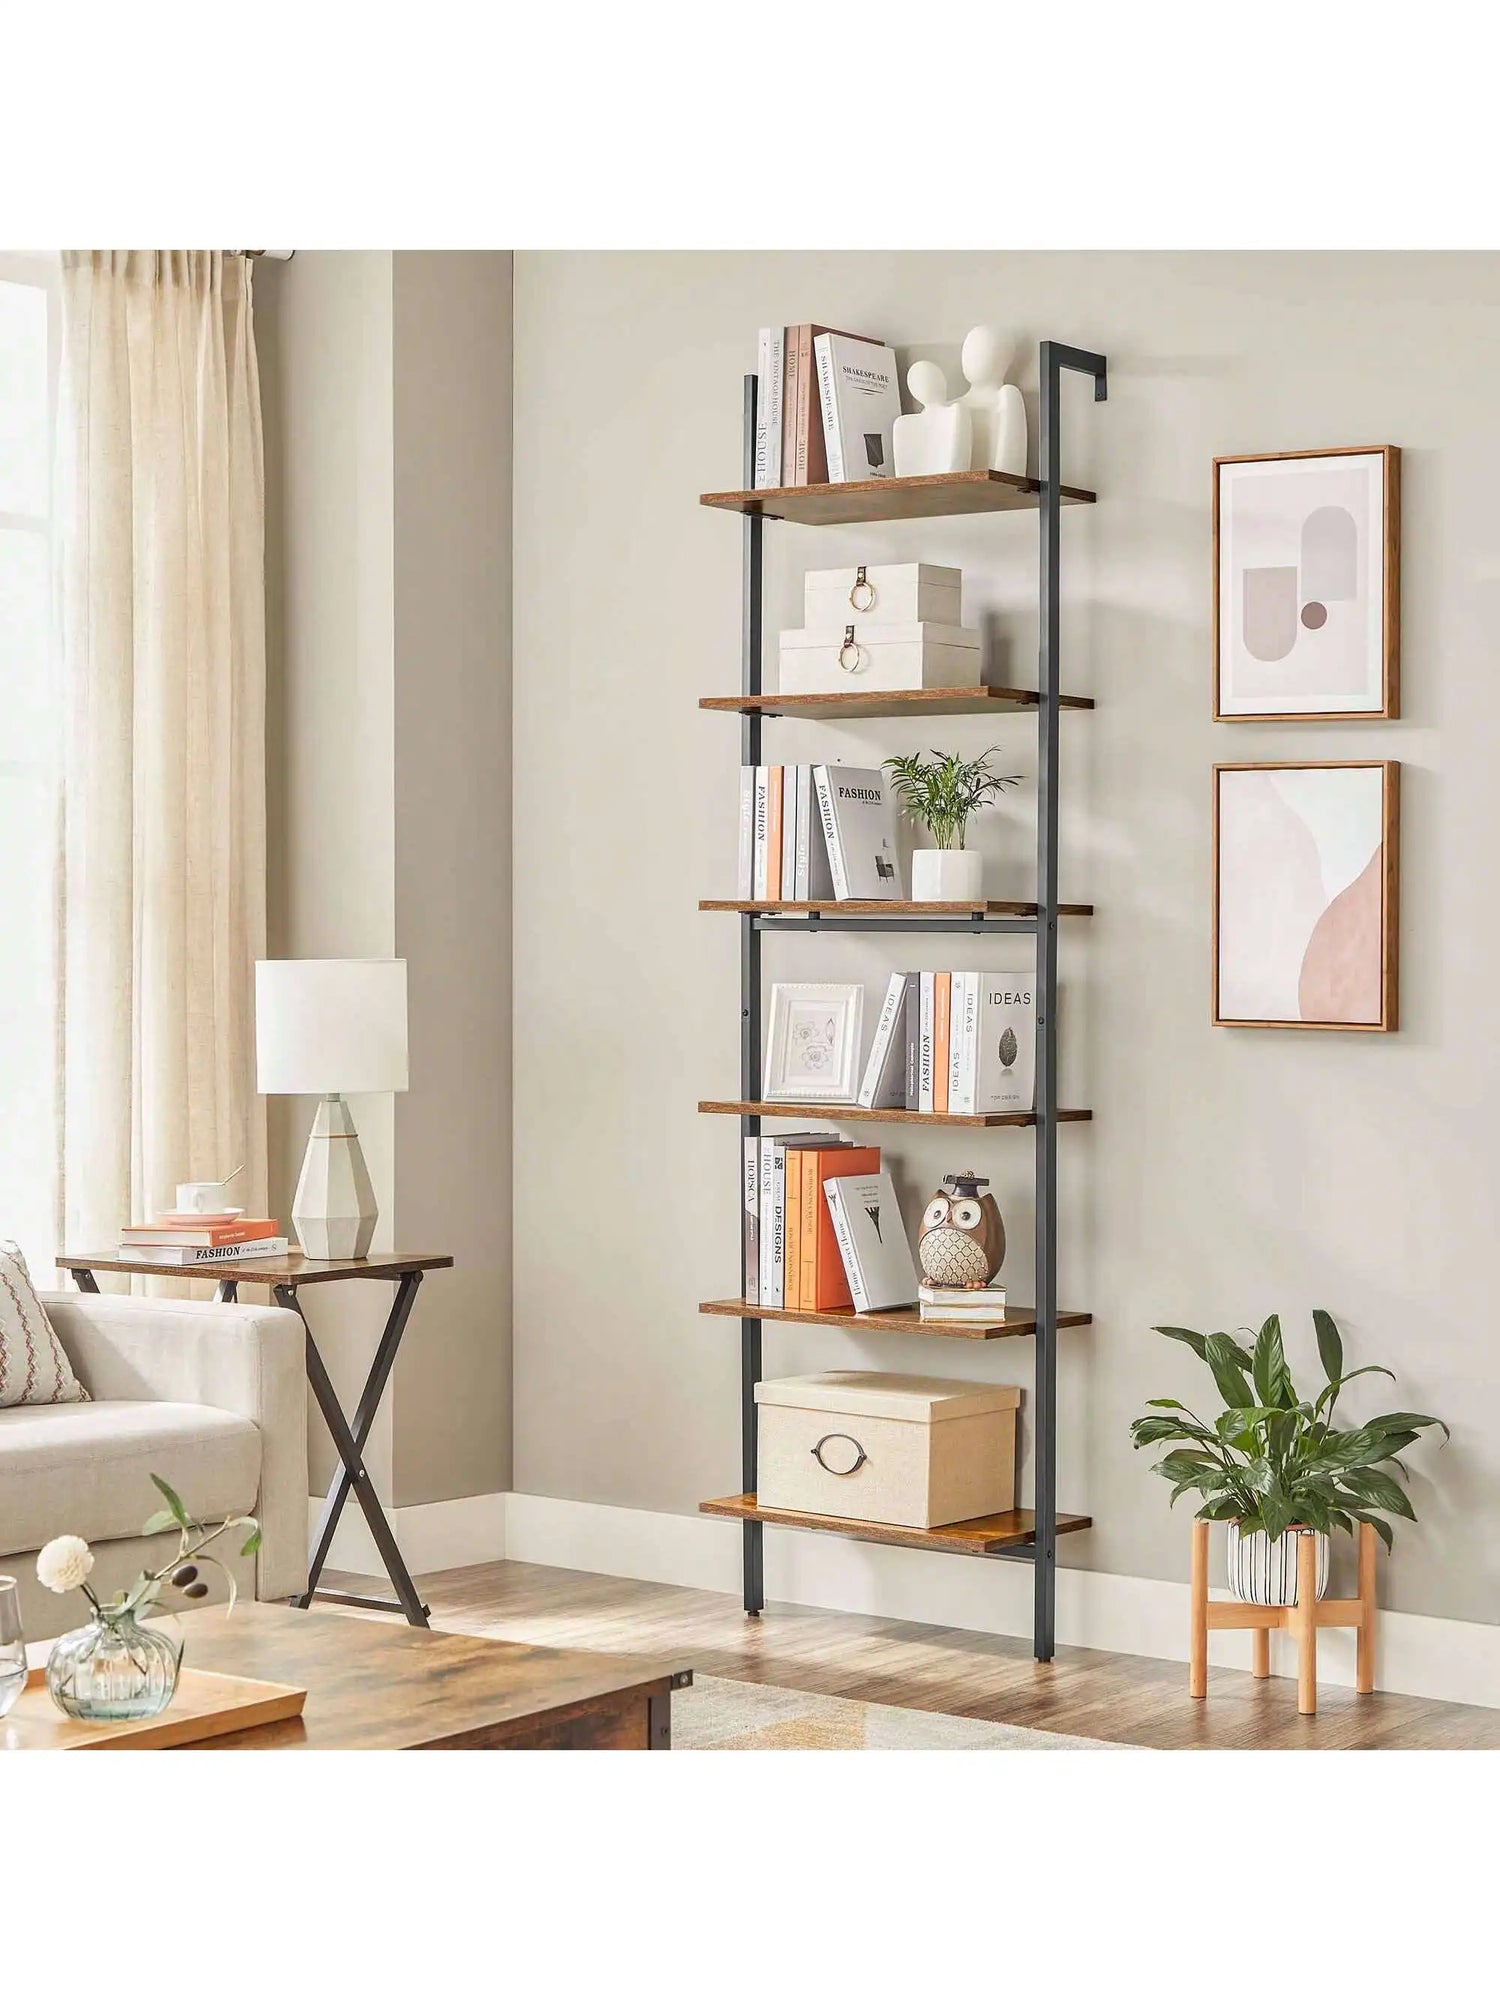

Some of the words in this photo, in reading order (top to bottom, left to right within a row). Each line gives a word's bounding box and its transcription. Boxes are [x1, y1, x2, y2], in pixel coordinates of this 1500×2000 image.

[788, 350, 796, 380] HOME
[842, 366, 889, 383] SHAKESPEARE
[771, 395, 779, 426] HOUSE
[820, 355, 835, 431] SHAKESPEARE
[757, 422, 768, 472] HOUSE
[798, 440, 806, 470] HOME
[758, 785, 766, 841] FASHION
[818, 785, 835, 840] FASHION
[838, 787, 881, 801] FASHION
[881, 993, 896, 1032] IDEAS
[966, 993, 974, 1033] IDEAS
[989, 992, 1031, 1005] IDEAS
[922, 1034, 930, 1092] FASHION
[952, 1052, 960, 1092] IDEAS
[747, 1159, 756, 1202] HOPSCA
[763, 1153, 771, 1195] HOUSE
[195, 1246, 241, 1260] FASHION
[774, 1206, 782, 1263] DESIGNS
[838, 1221, 850, 1246] Home
[849, 1271, 862, 1296] Home
